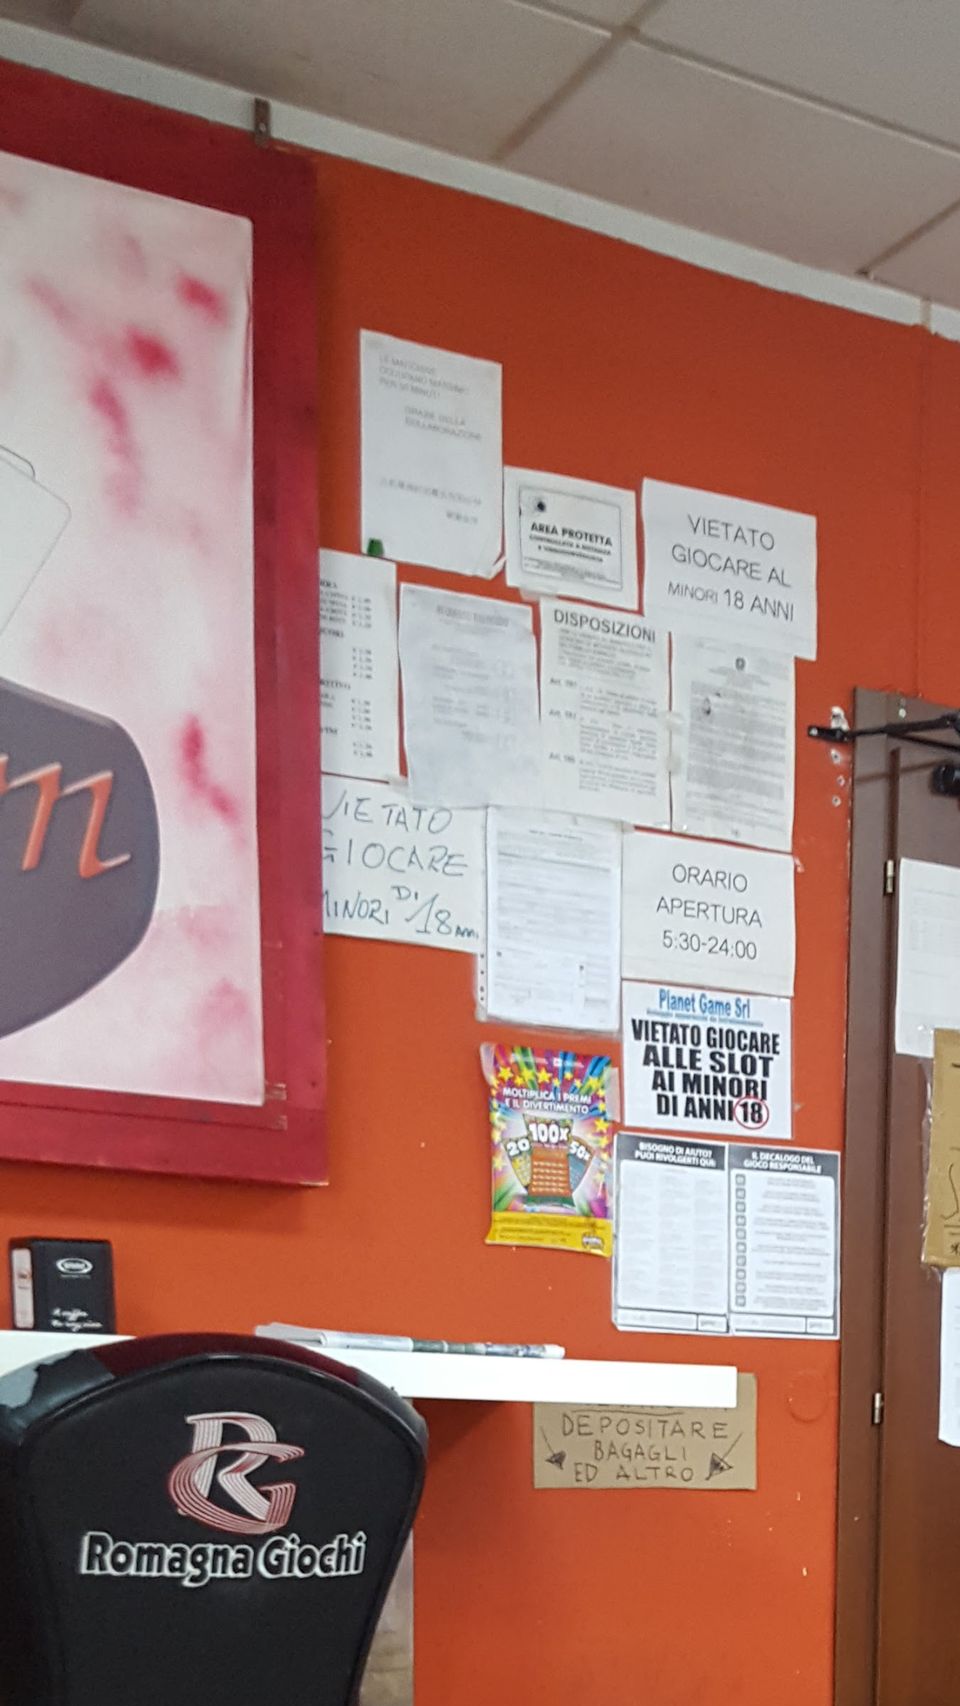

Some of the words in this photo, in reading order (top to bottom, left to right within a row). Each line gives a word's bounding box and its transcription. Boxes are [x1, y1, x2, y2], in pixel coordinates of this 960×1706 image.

[530, 522, 559, 536] AREA
[561, 527, 613, 547] PROTETTA
[687, 513, 776, 552] VIETATO
[671, 543, 763, 582] GIOCARE
[767, 566, 793, 589] AL
[667, 580, 719, 605] MINORI
[723, 588, 745, 610] 18
[750, 594, 795, 623] ANNI
[554, 609, 656, 644] DISPOSIZIONI
[672, 863, 749, 893] ORARIO
[405, 893, 452, 936] 18
[656, 896, 763, 929] APERTURA
[662, 929, 758, 961] 5:30-24:00
[659, 988, 697, 1011] Planet
[699, 993, 732, 1017] Game
[734, 997, 751, 1019] Srl
[631, 1018, 702, 1047] VIETATO
[706, 1026, 781, 1055] GIOCARE
[642, 1044, 702, 1071] ALLE
[709, 1051, 774, 1078] SLOT
[502, 1087, 556, 1101] MOLTIPLICA
[562, 1092, 592, 1105] PREMI
[651, 1070, 676, 1092] AI
[681, 1072, 768, 1101] MINORI
[512, 1099, 520, 1108] IL
[523, 1100, 589, 1114] DIVERTIMENTO
[656, 1093, 678, 1117] DI
[684, 1097, 734, 1121] ANNI
[738, 1101, 764, 1125] 18
[528, 1122, 570, 1144] 100x
[634, 1150, 656, 1161] PUOI
[655, 1152, 699, 1166] RIVOLGERTI
[638, 1141, 675, 1155] BISOGNO
[685, 1146, 713, 1160] AIUTO?
[743, 1158, 769, 1169] GIOCO
[769, 1160, 823, 1174] RESPONSABILE
[751, 1151, 759, 1159] IL
[759, 1152, 801, 1165] DECALOGO
[800, 1156, 815, 1165] DEL
[562, 1412, 728, 1440] DEPOSITARE
[594, 1440, 688, 1462] BAGAGLI
[574, 1462, 599, 1483] ED
[615, 1464, 694, 1483] ALTRO
[80, 1530, 253, 1589] Romagna
[256, 1530, 368, 1580] Giochi
